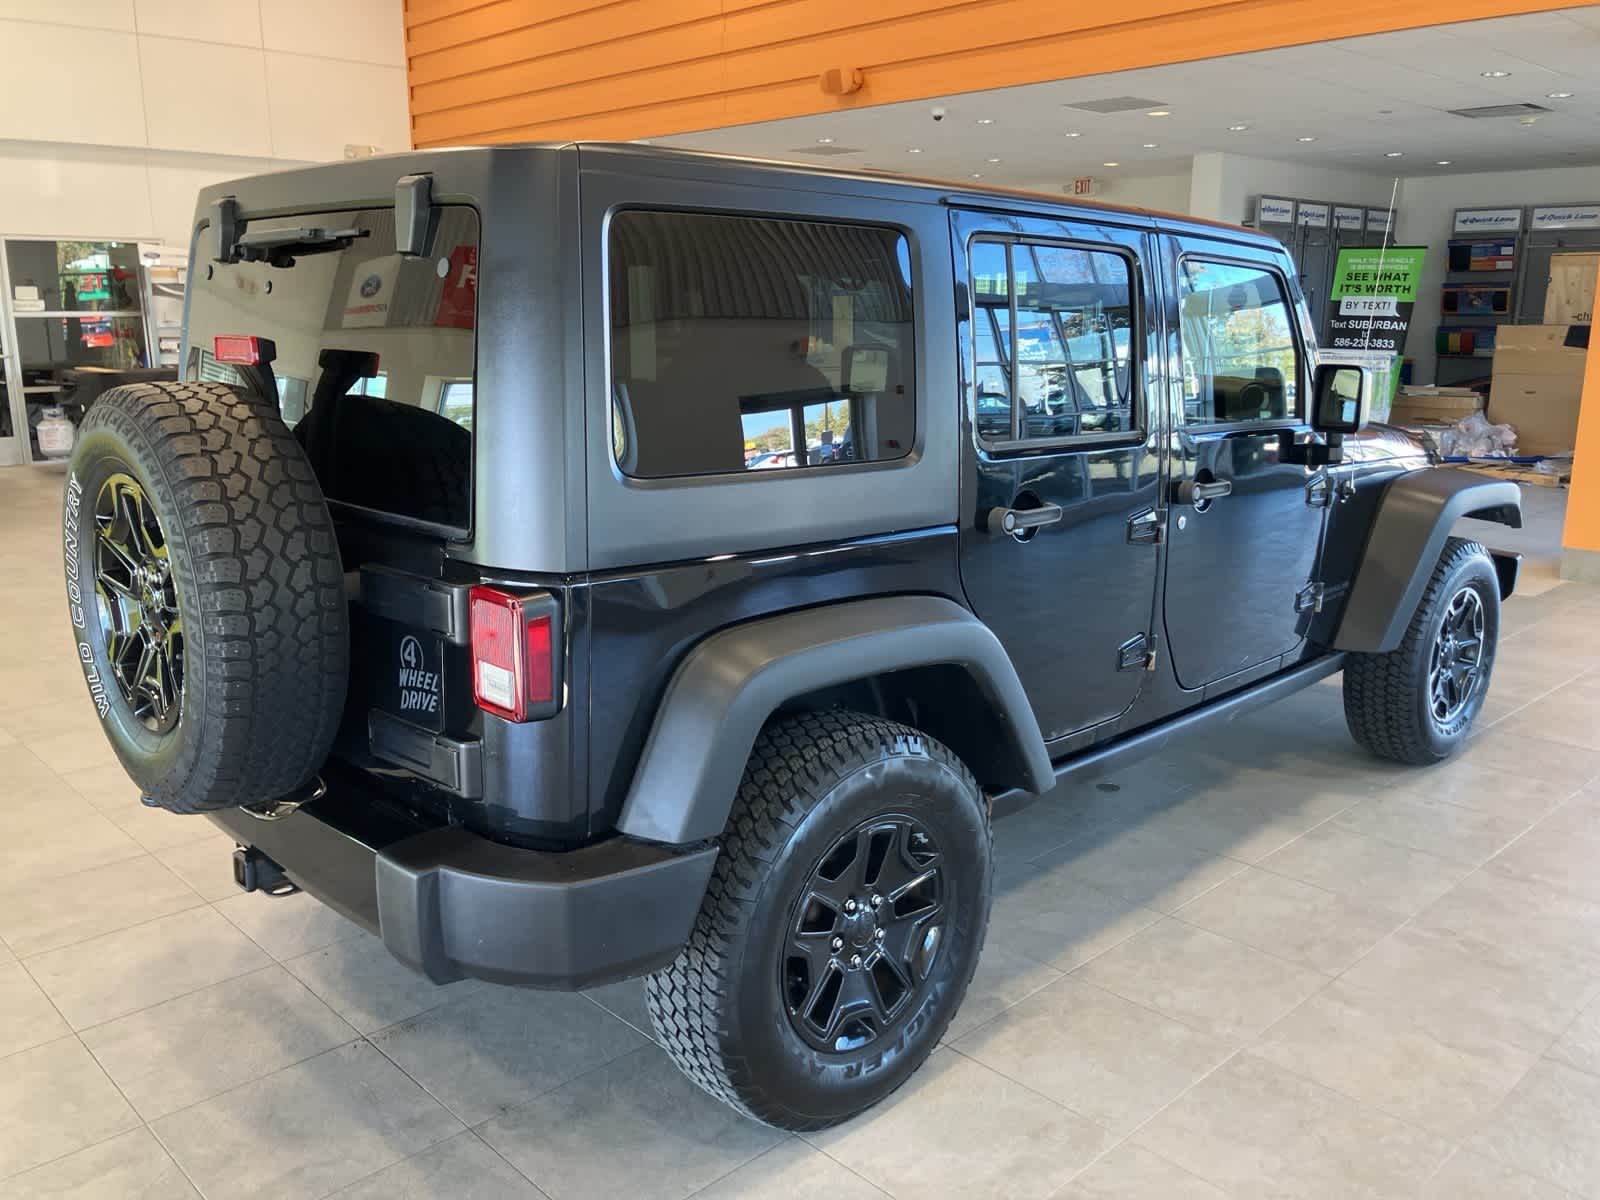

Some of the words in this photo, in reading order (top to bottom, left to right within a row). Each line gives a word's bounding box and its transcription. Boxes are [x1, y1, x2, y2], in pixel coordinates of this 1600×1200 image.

[1075, 180, 1091, 194] EXIT
[1469, 216, 1493, 225] Quick
[1548, 213, 1573, 222] Quick
[1345, 272, 1370, 282] SEE
[1373, 272, 1410, 282] WHAT
[1339, 284, 1361, 294] IT'S
[1365, 284, 1412, 294] WORTH
[1345, 301, 1360, 310] BY
[1362, 302, 1391, 311] TEXT!
[1330, 320, 1347, 329] Text
[1348, 320, 1408, 331] SUBURBAN
[1361, 331, 1371, 339] to
[65, 471, 86, 629] COUNTRY
[404, 641, 417, 668] 4
[79, 642, 112, 719] WILD
[400, 668, 438, 692] WHEEL
[400, 689, 438, 712] DRIVE
